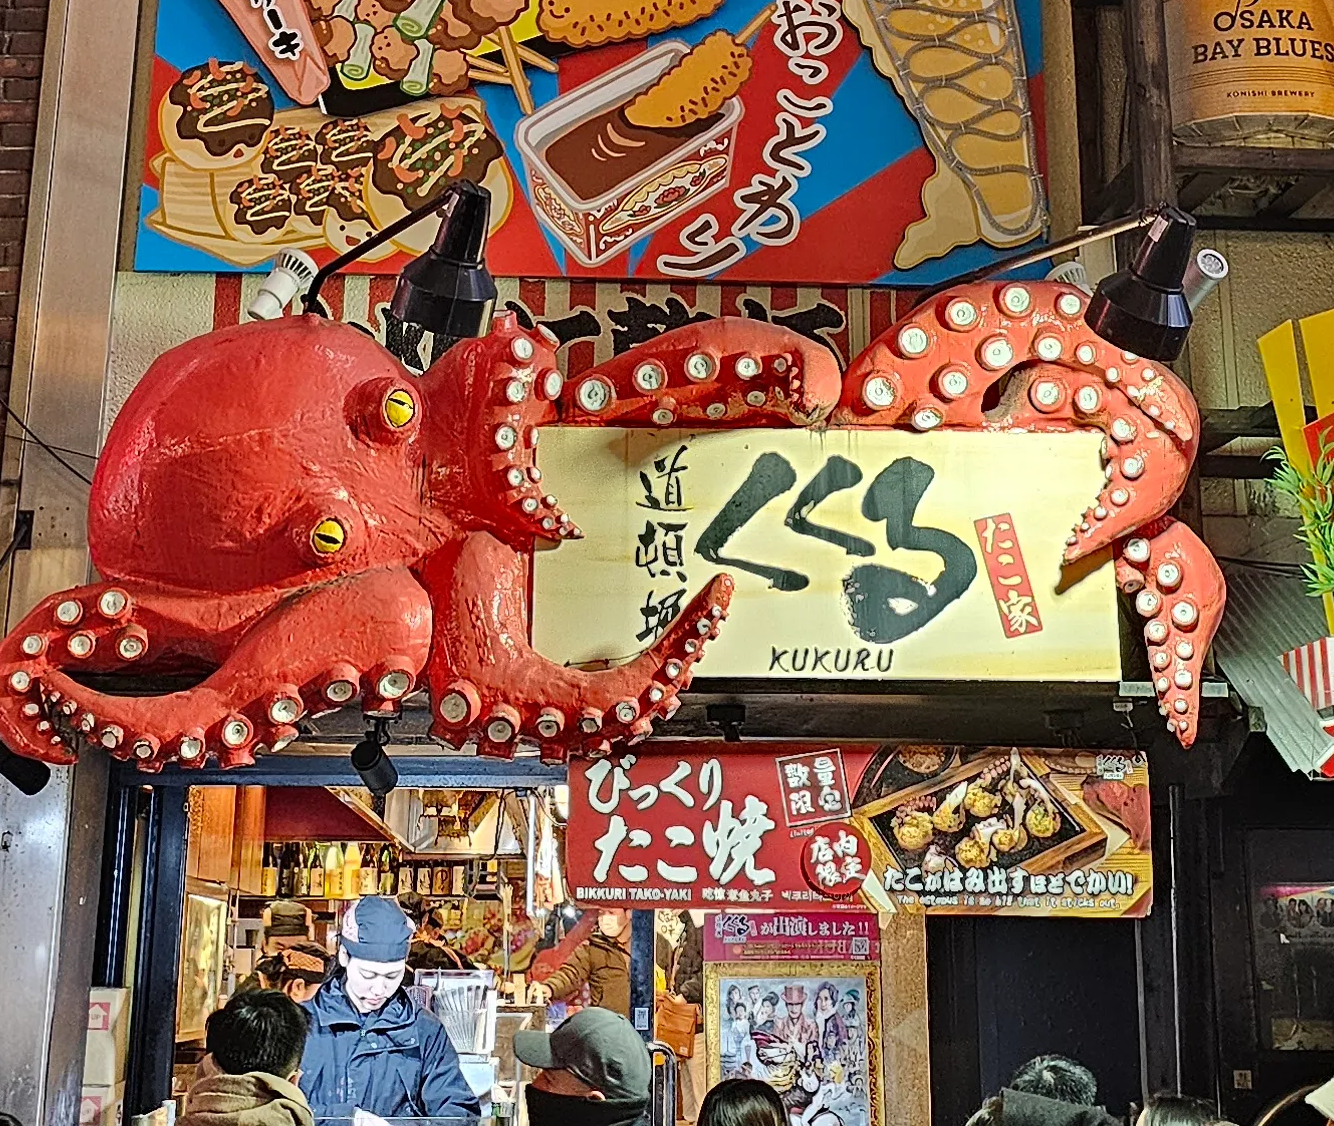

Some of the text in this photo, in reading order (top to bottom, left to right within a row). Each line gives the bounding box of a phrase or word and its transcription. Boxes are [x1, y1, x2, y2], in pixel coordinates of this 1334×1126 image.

[1212, 7, 1314, 33] OSAKA
[1192, 40, 1247, 65] BAY
[1225, 89, 1315, 99] KONISHI BREWERY
[635, 445, 694, 642] 道頓堀
[693, 451, 978, 645] くくる
[979, 515, 1041, 635] たこ家
[769, 645, 896, 673] KUKURU
[584, 753, 723, 814] びっくり
[784, 756, 837, 788] 数量
[788, 786, 844, 816] 限定
[593, 794, 777, 886] たこ焼
[810, 830, 858, 864] 店内
[814, 856, 866, 887] 限定
[576, 887, 628, 900] BIKKURI
[628, 887, 692, 900] TAKO-YAKI
[897, 895, 915, 905] The
